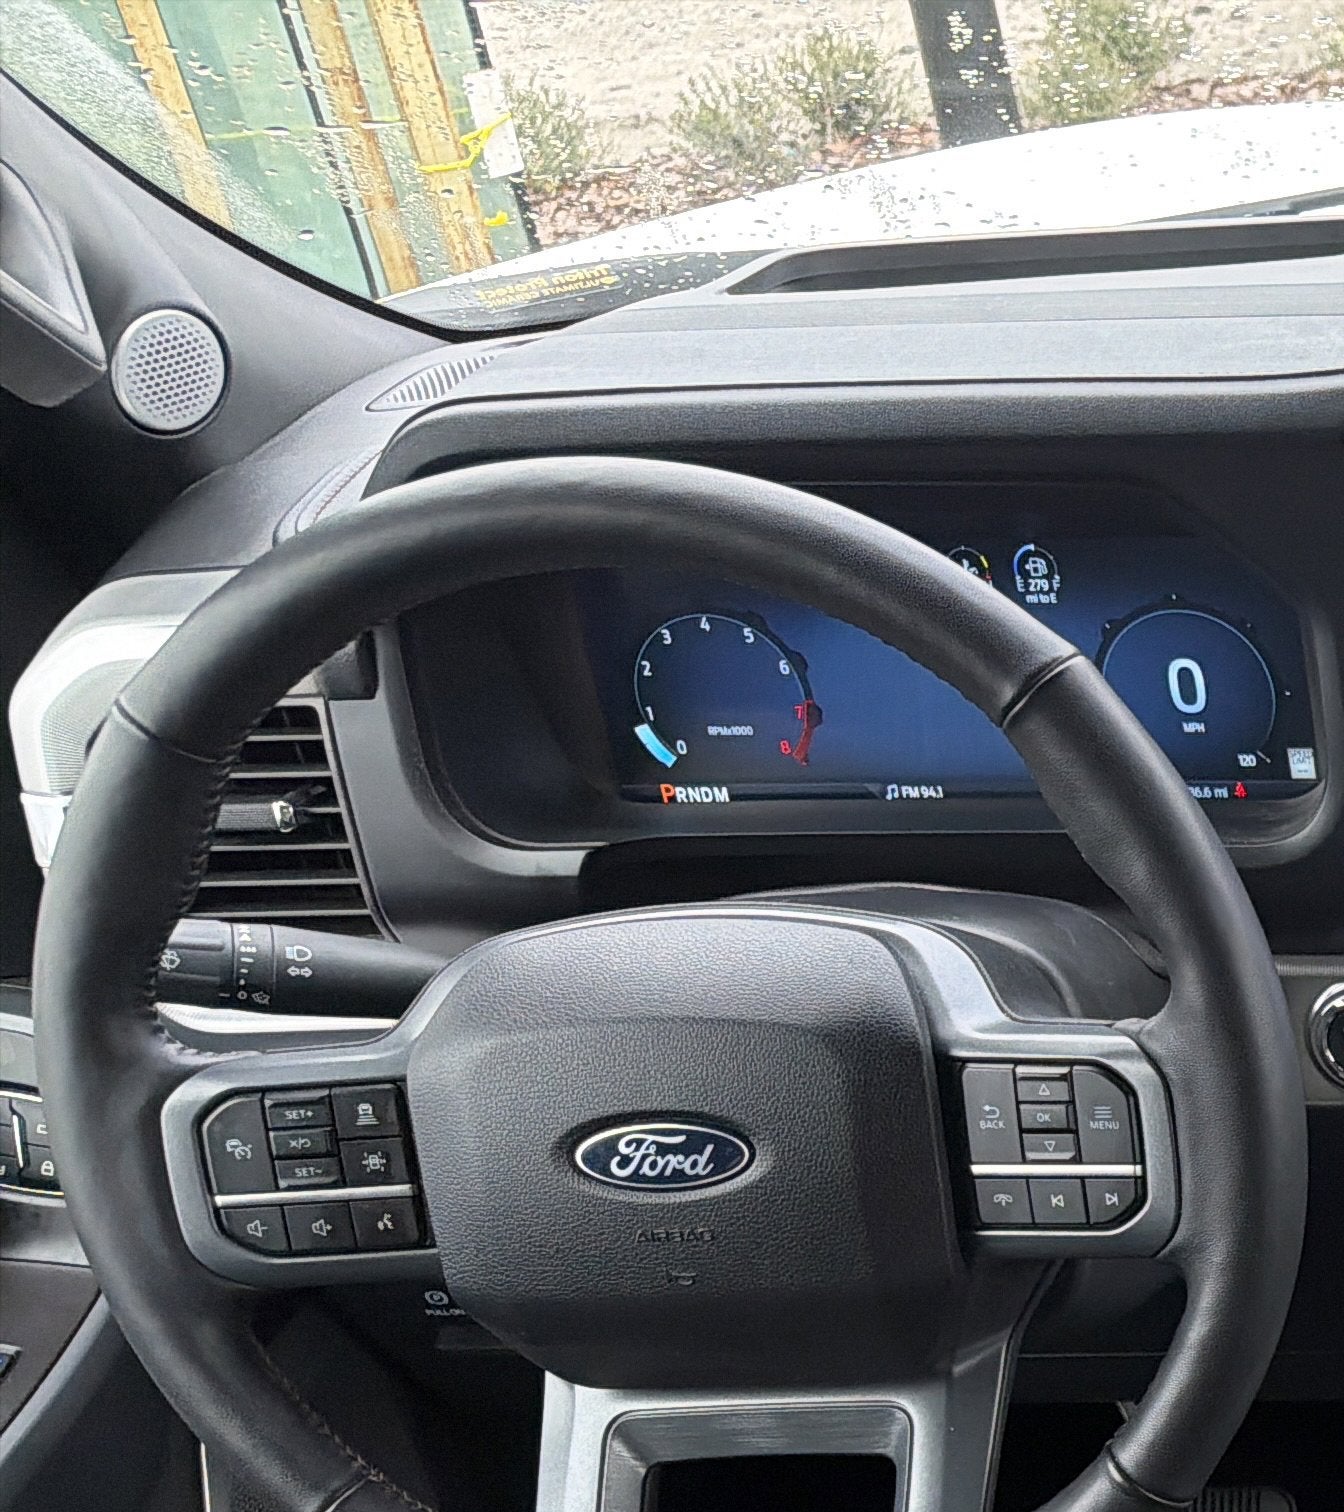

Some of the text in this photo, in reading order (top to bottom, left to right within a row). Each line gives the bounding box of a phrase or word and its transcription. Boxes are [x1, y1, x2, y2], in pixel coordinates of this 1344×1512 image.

[1028, 579, 1049, 592] 279
[699, 616, 711, 632] 4
[660, 629, 672, 645] 3
[743, 628, 754, 643] 5
[641, 661, 652, 676] 2
[779, 660, 790, 675] 6
[1168, 658, 1207, 714] 0
[645, 706, 654, 721] 1
[794, 705, 803, 719] 7
[1181, 722, 1206, 733] MPH
[676, 740, 687, 754] 0
[780, 740, 791, 754] 8
[1237, 753, 1257, 767] 120
[900, 785, 944, 799] FM 94.1
[1213, 786, 1229, 798] mi
[1036, 1112, 1051, 1122] OK
[979, 1121, 1006, 1129] BACK
[1089, 1121, 1120, 1130] MENU
[610, 1133, 715, 1178] Ford
